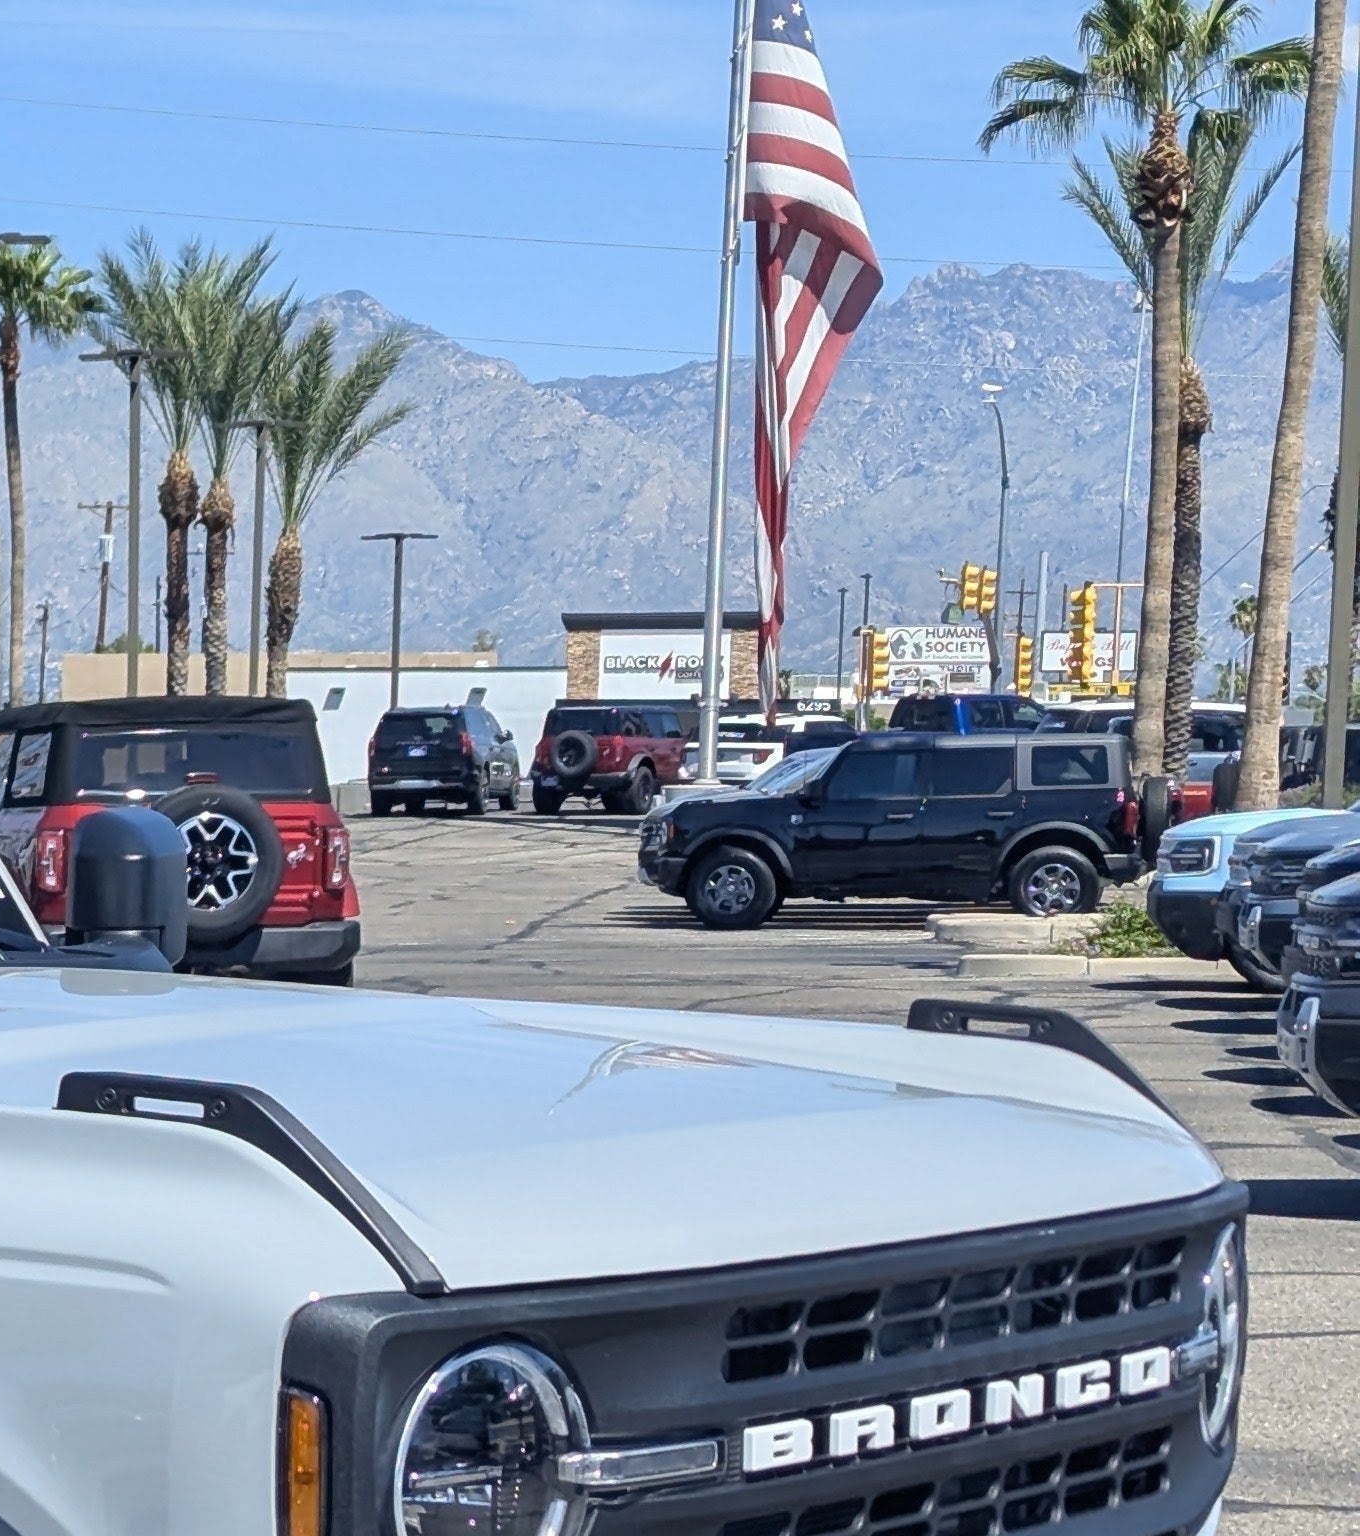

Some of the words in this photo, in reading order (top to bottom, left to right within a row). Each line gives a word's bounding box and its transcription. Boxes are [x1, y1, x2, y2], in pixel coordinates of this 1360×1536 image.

[925, 628, 987, 639] HUMANE
[924, 641, 986, 653] SOCIETY
[605, 655, 661, 671] BLACK
[742, 1345, 1172, 1474] BRONCO
